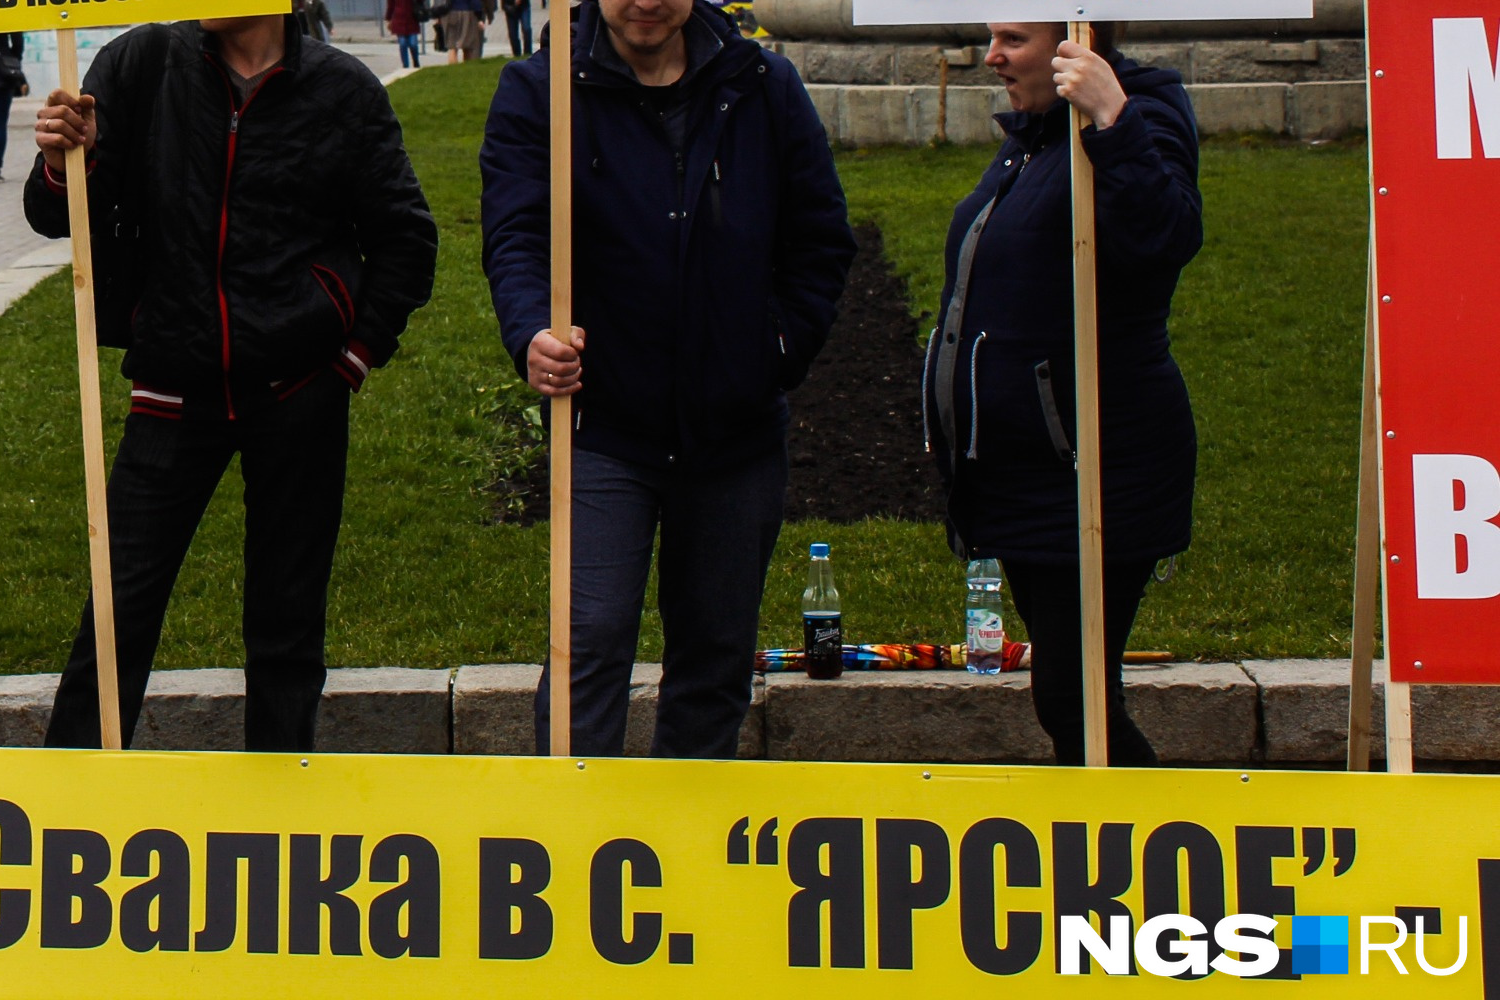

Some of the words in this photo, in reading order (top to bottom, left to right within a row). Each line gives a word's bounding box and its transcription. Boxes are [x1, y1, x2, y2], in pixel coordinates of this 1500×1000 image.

[479, 838, 553, 959] в
[590, 839, 693, 964] с.
[728, 817, 1355, 980] “ЯРСКОЕ”
